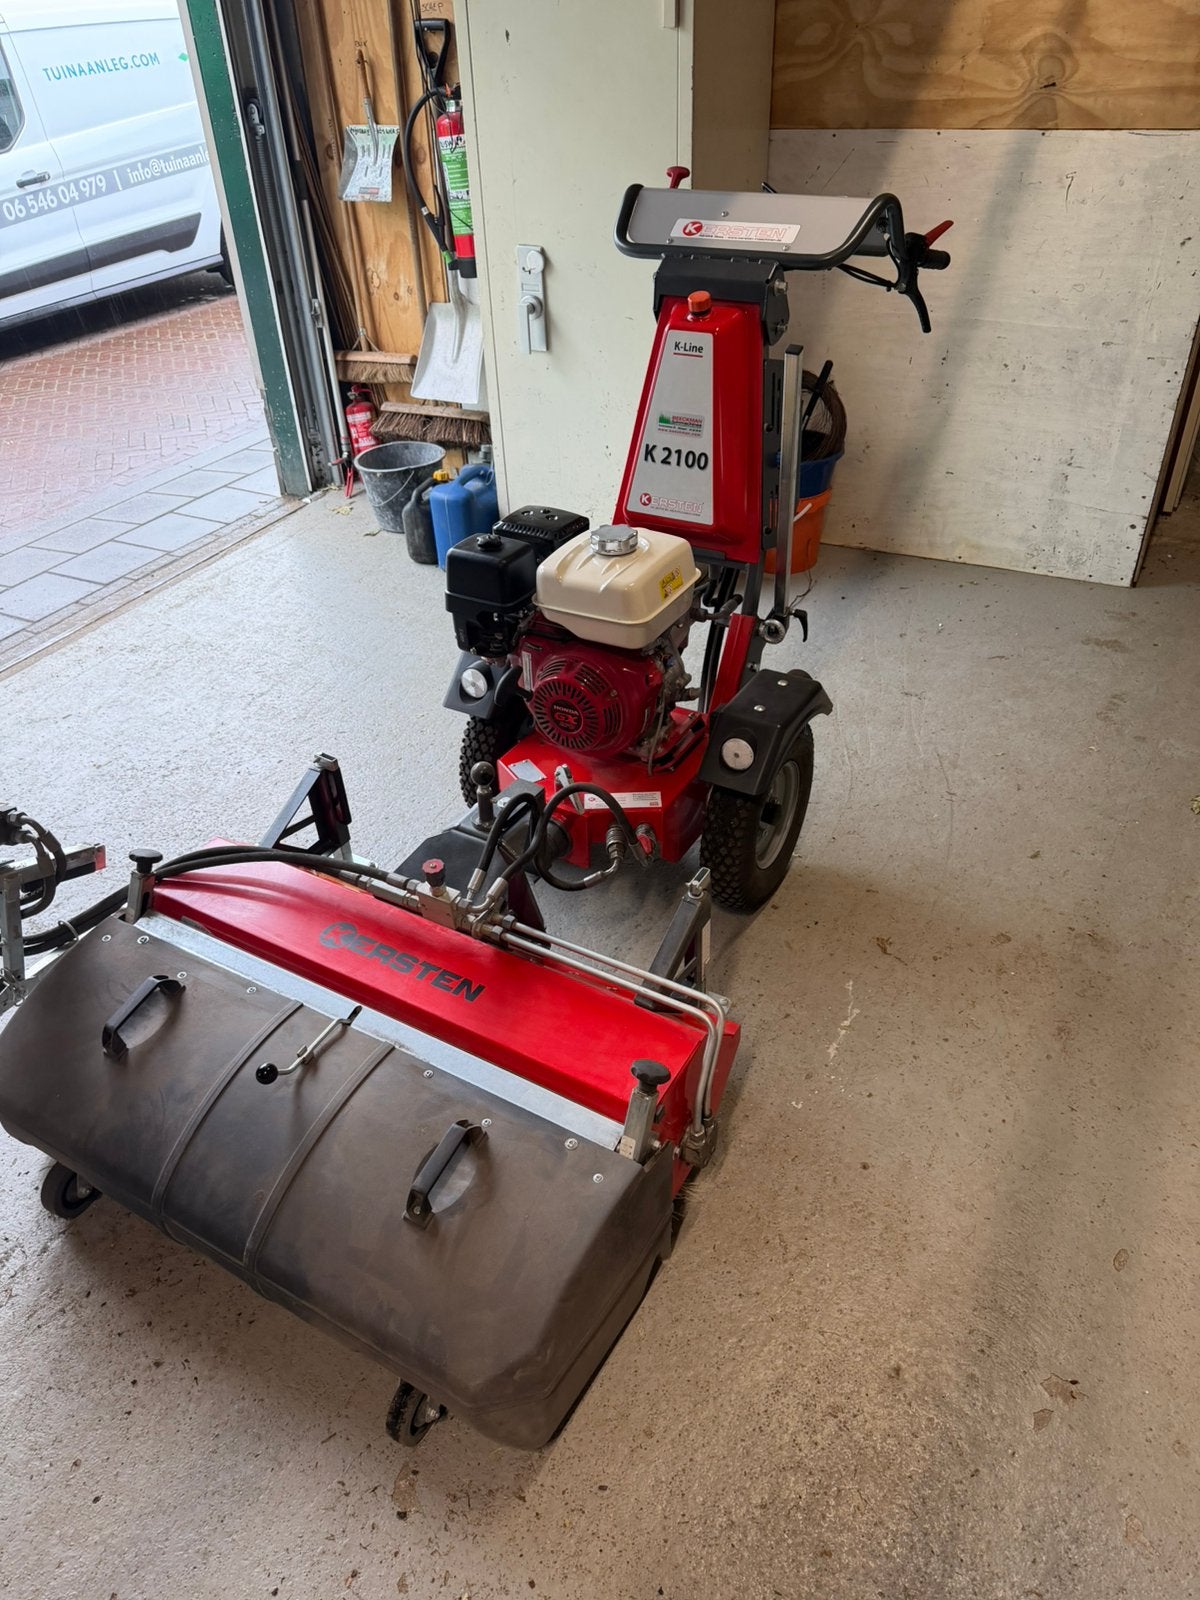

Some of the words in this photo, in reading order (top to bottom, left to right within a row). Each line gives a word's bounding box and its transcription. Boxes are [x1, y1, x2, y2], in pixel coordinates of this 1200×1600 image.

[42, 52, 161, 82] TUINAANLEG.COM
[3, 202, 26, 221] 06
[27, 190, 57, 214] 546
[58, 184, 79, 203] 04
[80, 174, 106, 198] 979
[683, 221, 788, 240] KERSTEN
[674, 341, 704, 354] K-Line
[644, 443, 657, 463] K
[660, 446, 709, 471] 2100
[640, 492, 704, 514] KERSTEN
[320, 922, 485, 1003] KERSTEN
